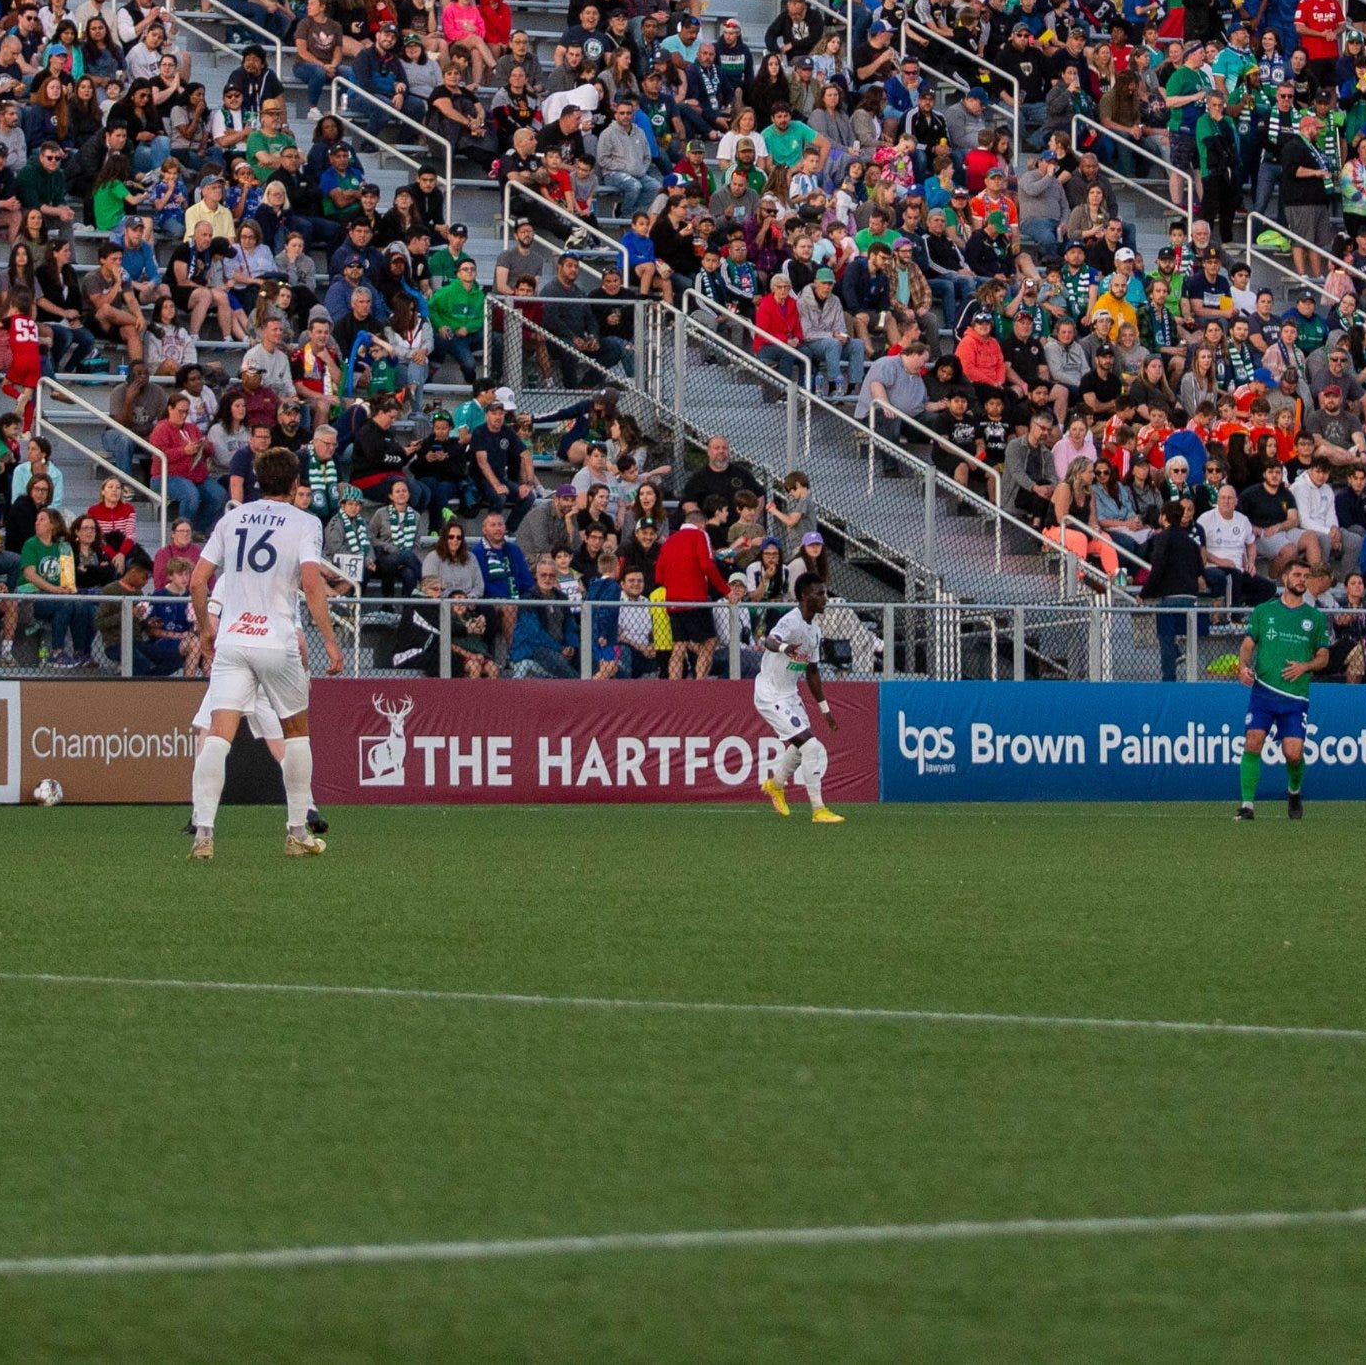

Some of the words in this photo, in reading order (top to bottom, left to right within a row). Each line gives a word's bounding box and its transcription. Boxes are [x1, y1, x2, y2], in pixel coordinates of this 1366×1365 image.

[240, 513, 287, 527] SMITH
[234, 527, 278, 573] 16
[239, 612, 268, 624] Auto
[236, 624, 269, 636] Zone
[898, 710, 956, 775] bps
[971, 723, 1086, 765] Brown
[413, 736, 513, 786] THE
[538, 736, 826, 787] HARTFOR
[925, 762, 956, 774] lawyers
